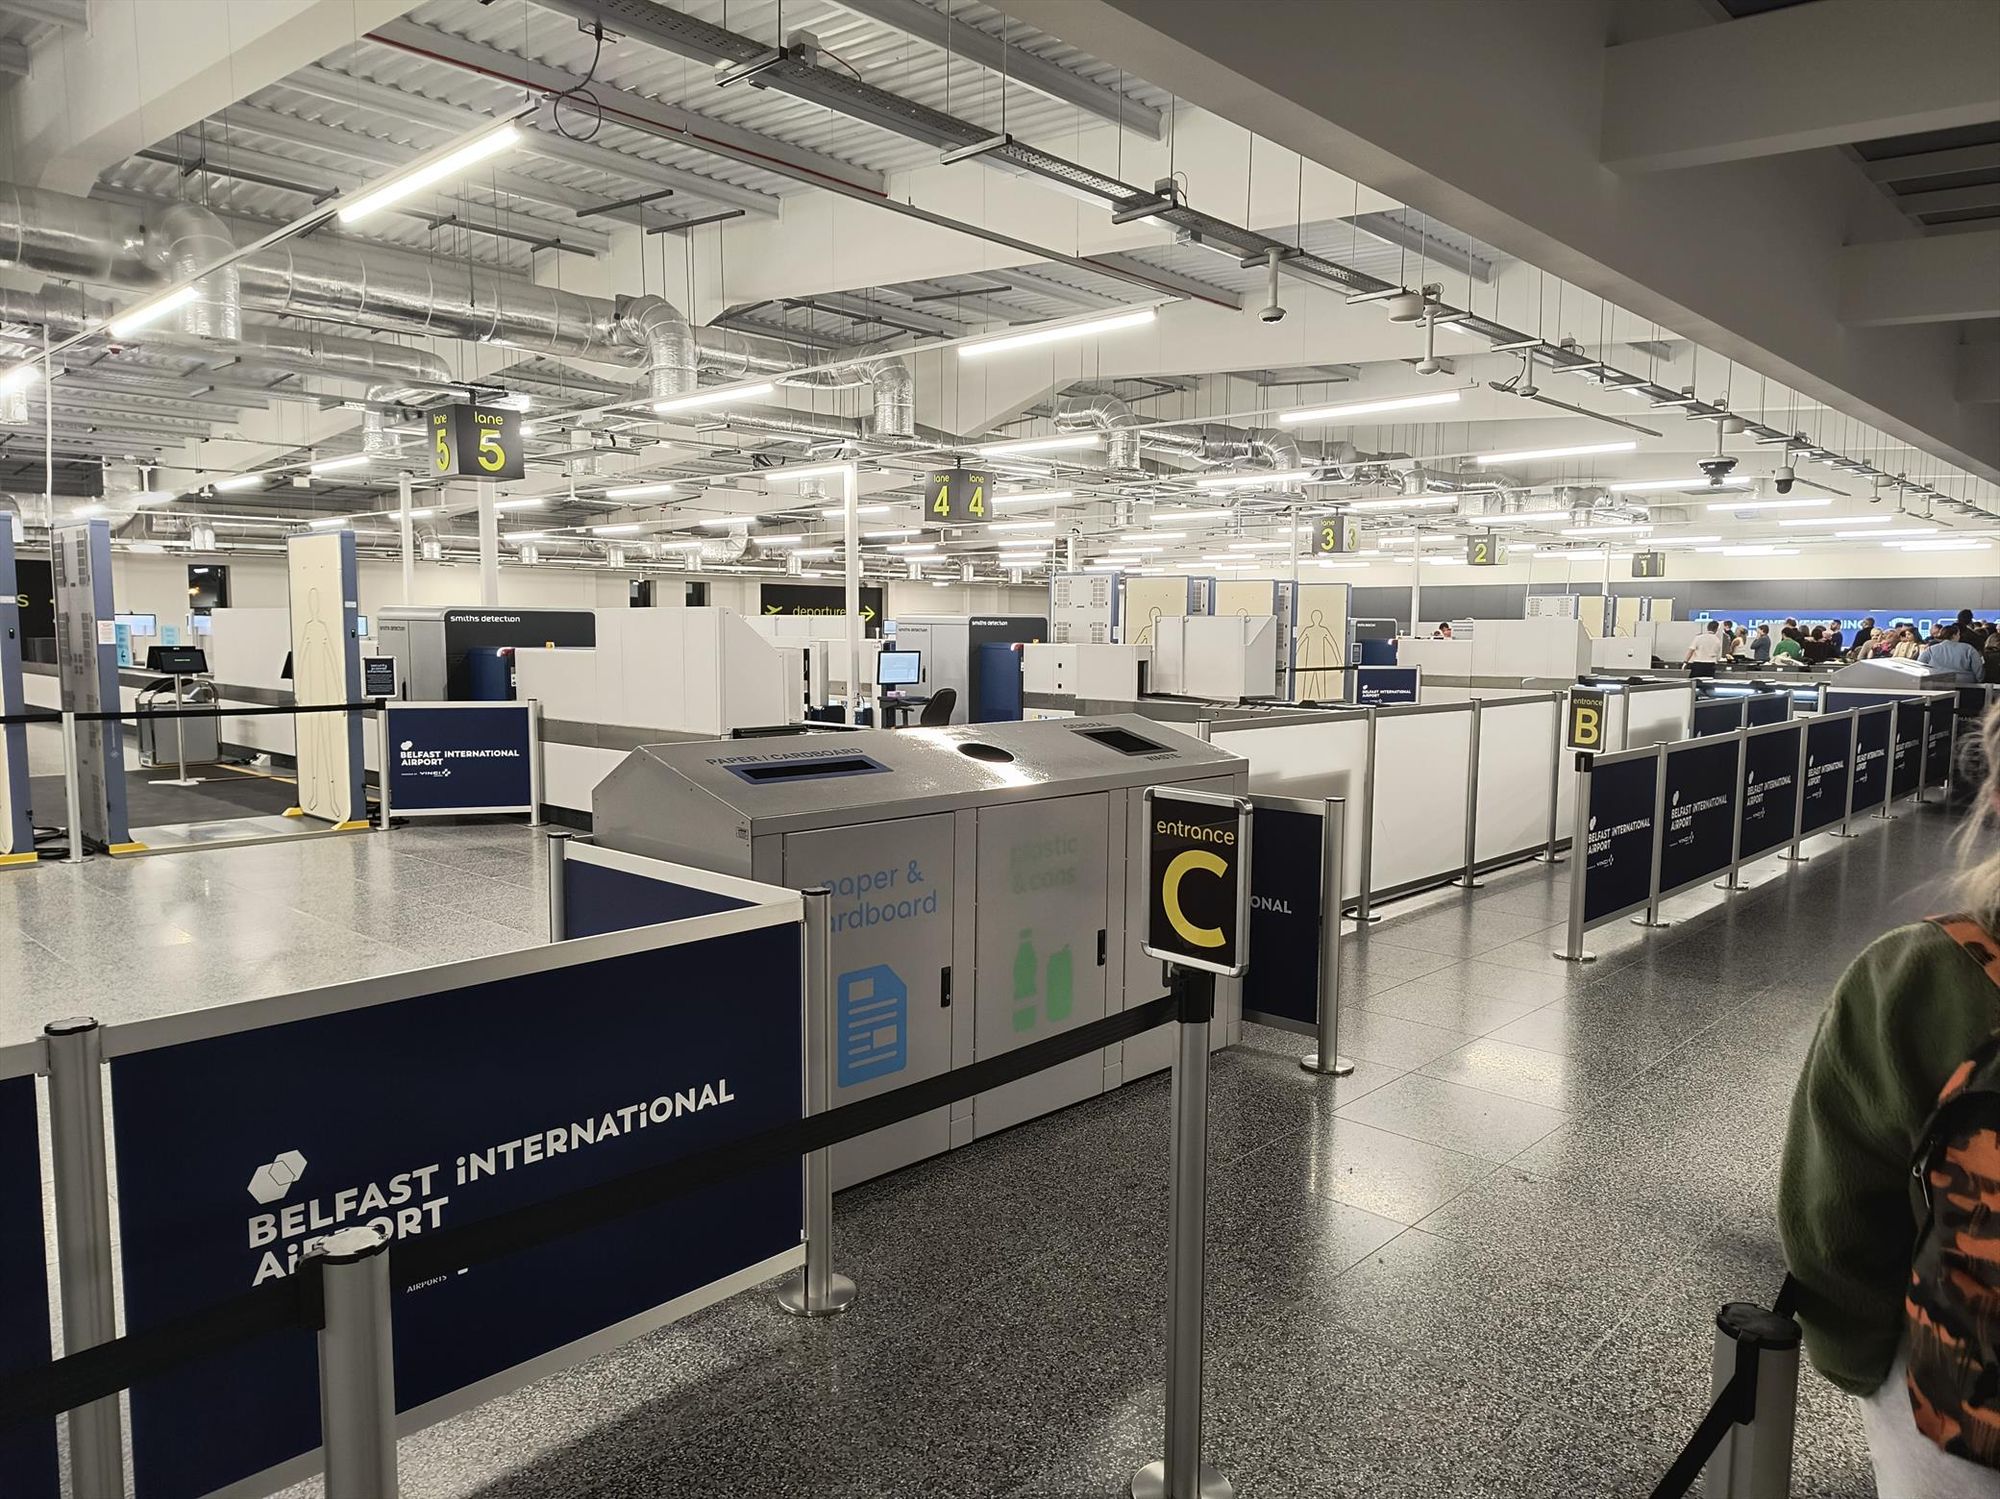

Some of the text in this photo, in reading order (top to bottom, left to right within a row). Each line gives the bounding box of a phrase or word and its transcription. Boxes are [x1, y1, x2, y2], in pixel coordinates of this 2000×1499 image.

[433, 414, 447, 425] lane
[474, 411, 504, 425] lane
[436, 428, 450, 471] 5
[478, 428, 506, 472] 5
[933, 474, 950, 483] lane
[969, 473, 985, 483] lane
[933, 485, 950, 517] 4
[969, 486, 985, 517] 4
[1321, 528, 1335, 550] 3
[1474, 543, 1487, 563] 2
[1640, 560, 1647, 576] 1
[450, 615, 521, 623] smiths detection
[792, 605, 847, 615] departure
[1573, 697, 1603, 706] entrance
[1575, 707, 1598, 744] B
[400, 749, 520, 759] BELFAST INTERNATIONAL
[401, 758, 443, 766] AIRPORT
[705, 755, 758, 766] PAPER
[770, 747, 865, 761] CARDBOARD
[1671, 804, 1692, 819] BELFAST
[1156, 820, 1235, 846] entrance
[1588, 828, 1611, 843] BELFAST
[821, 860, 925, 900] paper &
[1162, 849, 1229, 948] C
[830, 888, 938, 933] rdboard
[248, 1163, 440, 1249] BELFAST
[252, 1196, 449, 1288] AiORT
